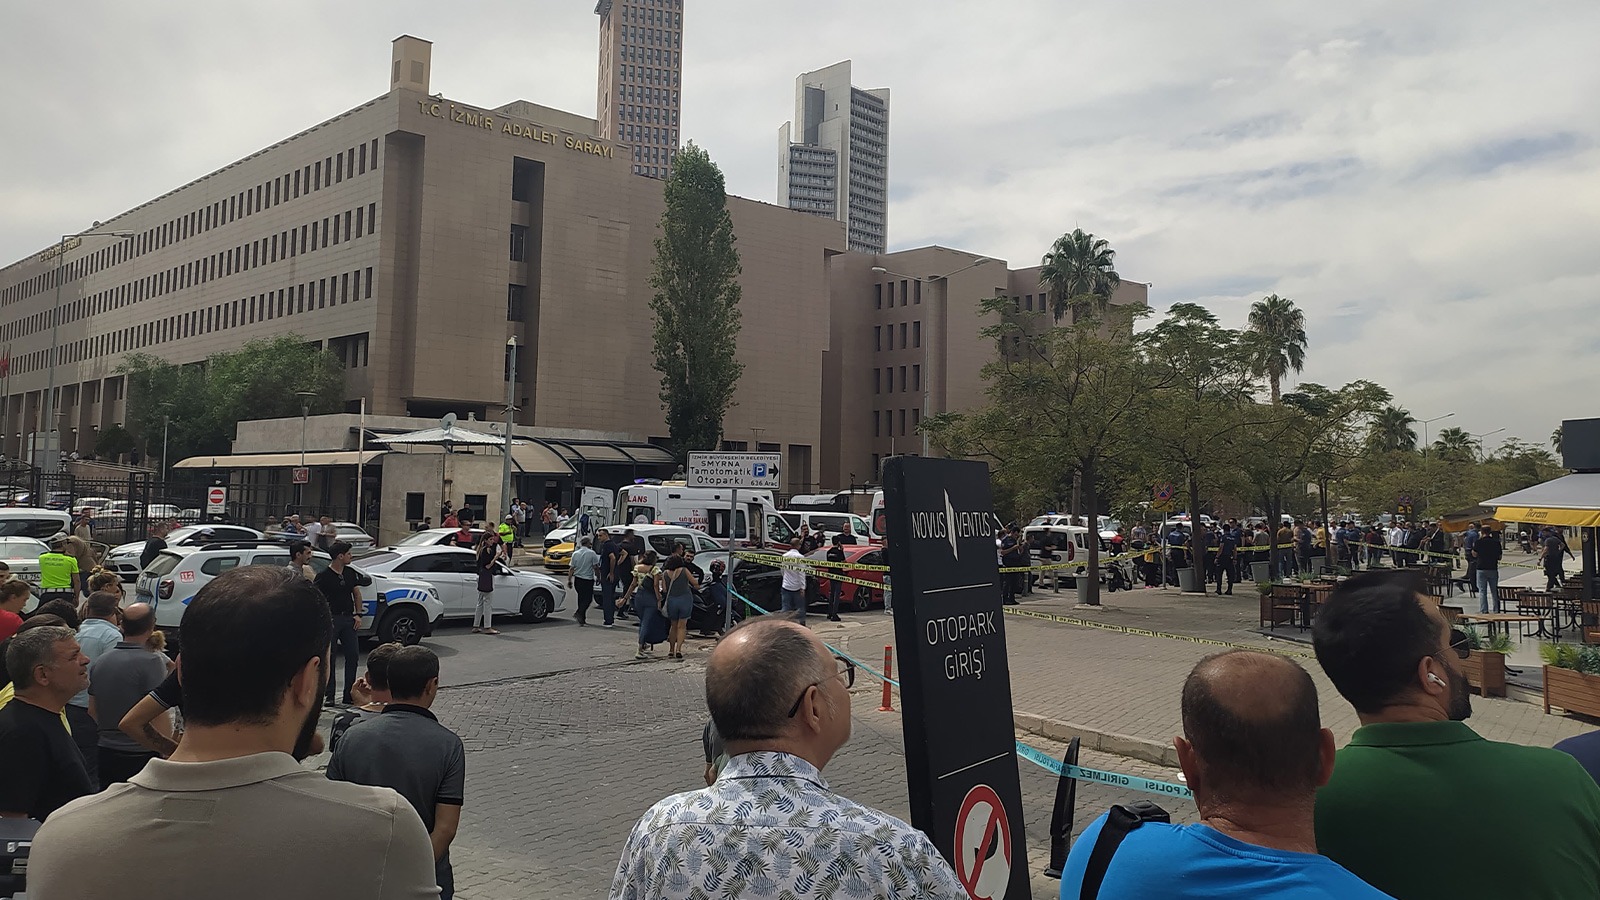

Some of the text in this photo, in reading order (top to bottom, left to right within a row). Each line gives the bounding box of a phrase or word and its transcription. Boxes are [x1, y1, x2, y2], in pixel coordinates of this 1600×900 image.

[418, 100, 613, 158] T.C. İZMİR ADALET SARAYI
[690, 466, 751, 476] Tamotomatik
[912, 511, 991, 539] NOVUS VENTUS
[181, 572, 194, 580] 112
[926, 611, 997, 646] OTOPARK
[944, 644, 986, 680] GİRİŞİ
